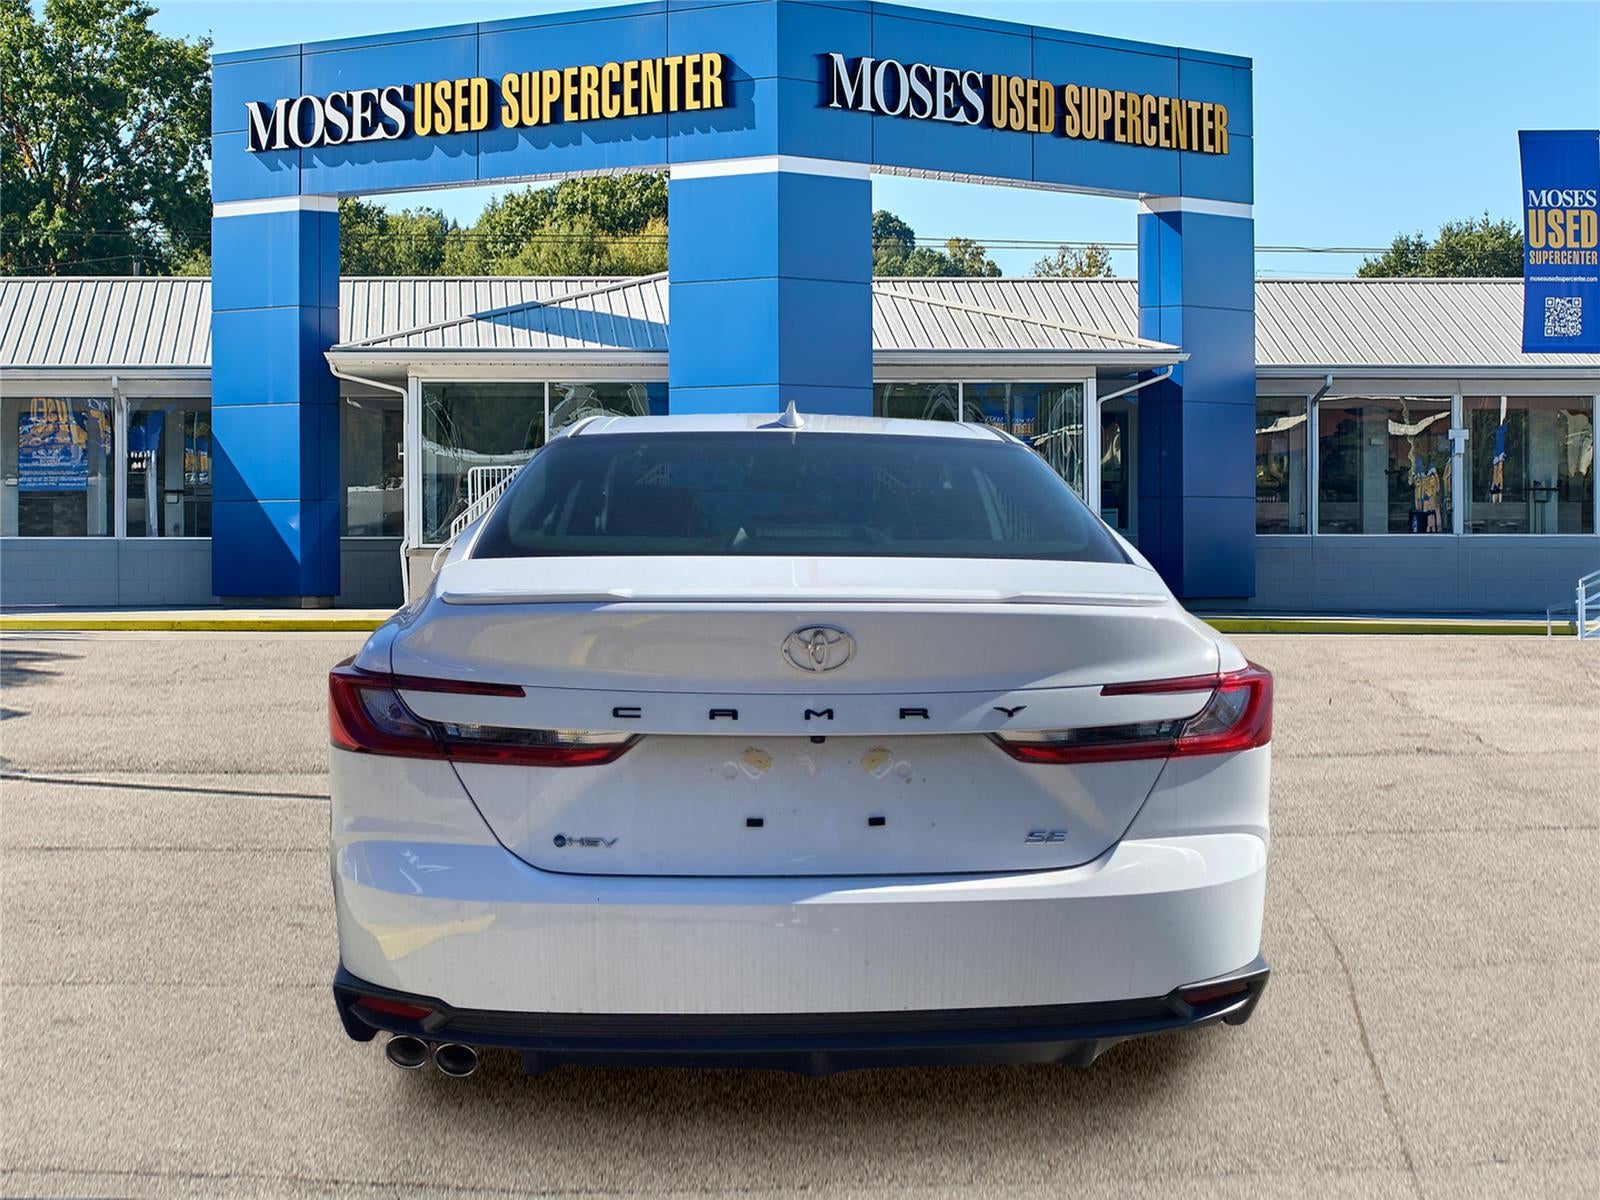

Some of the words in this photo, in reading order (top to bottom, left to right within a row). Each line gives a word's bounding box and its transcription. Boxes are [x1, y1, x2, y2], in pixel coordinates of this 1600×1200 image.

[245, 86, 406, 152] MOSES
[413, 77, 489, 137] USED
[501, 53, 723, 128] SUPERCENTER
[828, 52, 985, 126] MOSES
[991, 73, 1056, 133] USED
[1064, 83, 1230, 155] SUPERCENTER
[1527, 189, 1597, 208] MOSES
[1528, 209, 1598, 249] USED
[1529, 250, 1598, 265] SUPERCENTER
[612, 704, 1028, 721] CAMRY
[1024, 830, 1068, 845] SE
